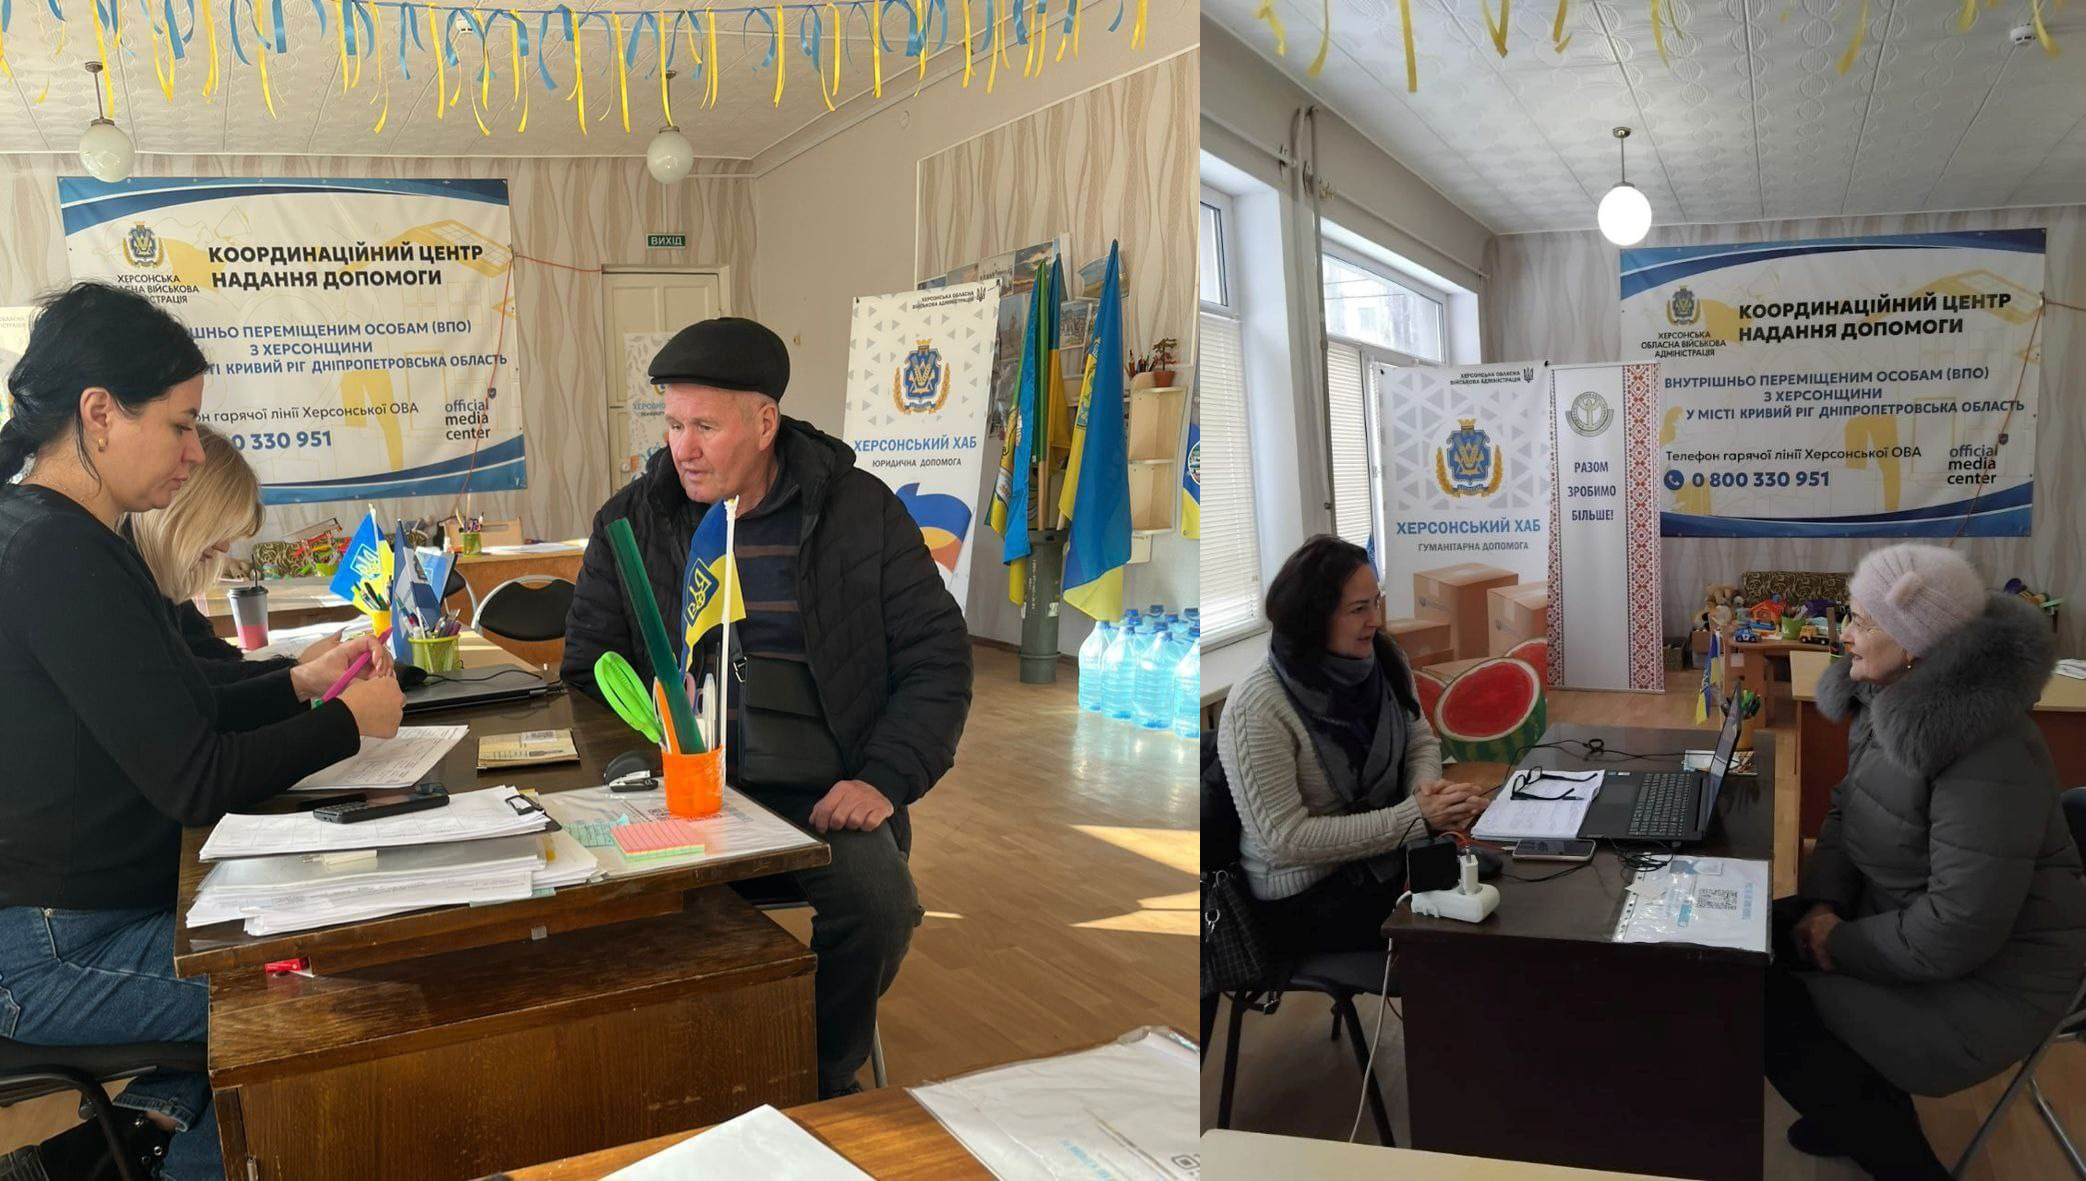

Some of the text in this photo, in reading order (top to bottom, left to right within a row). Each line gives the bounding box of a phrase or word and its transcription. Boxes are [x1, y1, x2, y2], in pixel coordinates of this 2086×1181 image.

[650, 236, 683, 246] ВИХІД
[209, 241, 483, 266] КООРДИНАЦІЙНИЙ ЦЕНТР
[117, 274, 181, 283] ХЕРСОНСЬКА
[211, 269, 442, 291] НАДАННЯ ДОПОМОГИ
[147, 283, 200, 293] ВІЙСЬКОВА
[1739, 291, 2012, 320] КООРДИНАЦІЙНИЙ ЦЕНТР
[243, 324, 361, 338] ПЕРЕМІЩЕНИМ
[364, 322, 429, 335] ОСОБАМ
[432, 320, 472, 334] (ВПО)
[1657, 331, 1711, 339] ХЕРСОНСЬКА
[1738, 318, 1964, 344] НАДАННЯ ДОПОМОГИ
[250, 342, 373, 356] З ХЕРСОНЩИНИ
[1641, 339, 1727, 349] ОБЛАСНА ВІЙСЬКОВА
[1654, 349, 1715, 358] АДМІНІСТРАЦІЯ
[226, 359, 283, 374] КРИВИЙ
[287, 361, 306, 373] РІГ
[312, 356, 447, 374] ДНІПРОПЕТРОВСЬКА
[450, 354, 507, 367] ОБЛАСТЬ
[1664, 367, 1989, 389] ВНУТРІШНЬО ПЕРЕМІЩЕНИМ ОСОБАМ (ВПО)
[1764, 388, 1882, 402] З ХЕРСОНЩИНИ
[445, 398, 489, 413] official
[1686, 400, 2025, 420] У МІСТІ КРИВИЙ РІГ ДНІПРОПЕТРОВСЬКА ОБЛАСТЬ
[214, 408, 267, 424] гарячої
[271, 407, 299, 420] лінії
[303, 405, 387, 420] Херсонської
[390, 402, 419, 415] ОВА
[445, 412, 489, 426] media
[250, 431, 291, 450] 330
[296, 430, 332, 448] 951
[446, 429, 491, 440] center
[853, 434, 977, 452] ХЕРСОНСЬКИЙ ХАБ
[1666, 446, 1922, 463] Телефон гарячої лінії Херсонської ОВА
[1949, 443, 1998, 458] official
[872, 457, 962, 468] ЮРИДИЧНА ДОПОМОГА
[1574, 461, 1609, 473] РАЗОМ
[1948, 457, 1996, 470] media
[1692, 471, 1830, 487] 0 800 330 951
[1947, 472, 1997, 485] center
[1568, 485, 1617, 498] ЗРОБИМО
[1571, 509, 1614, 522] БІЛЬШЕ!
[1396, 517, 1541, 535] ХЕРСОНСЬКИЙ ХАБ
[1418, 541, 1529, 552] ГУМАНІТАРНА ДОПОМОГА
